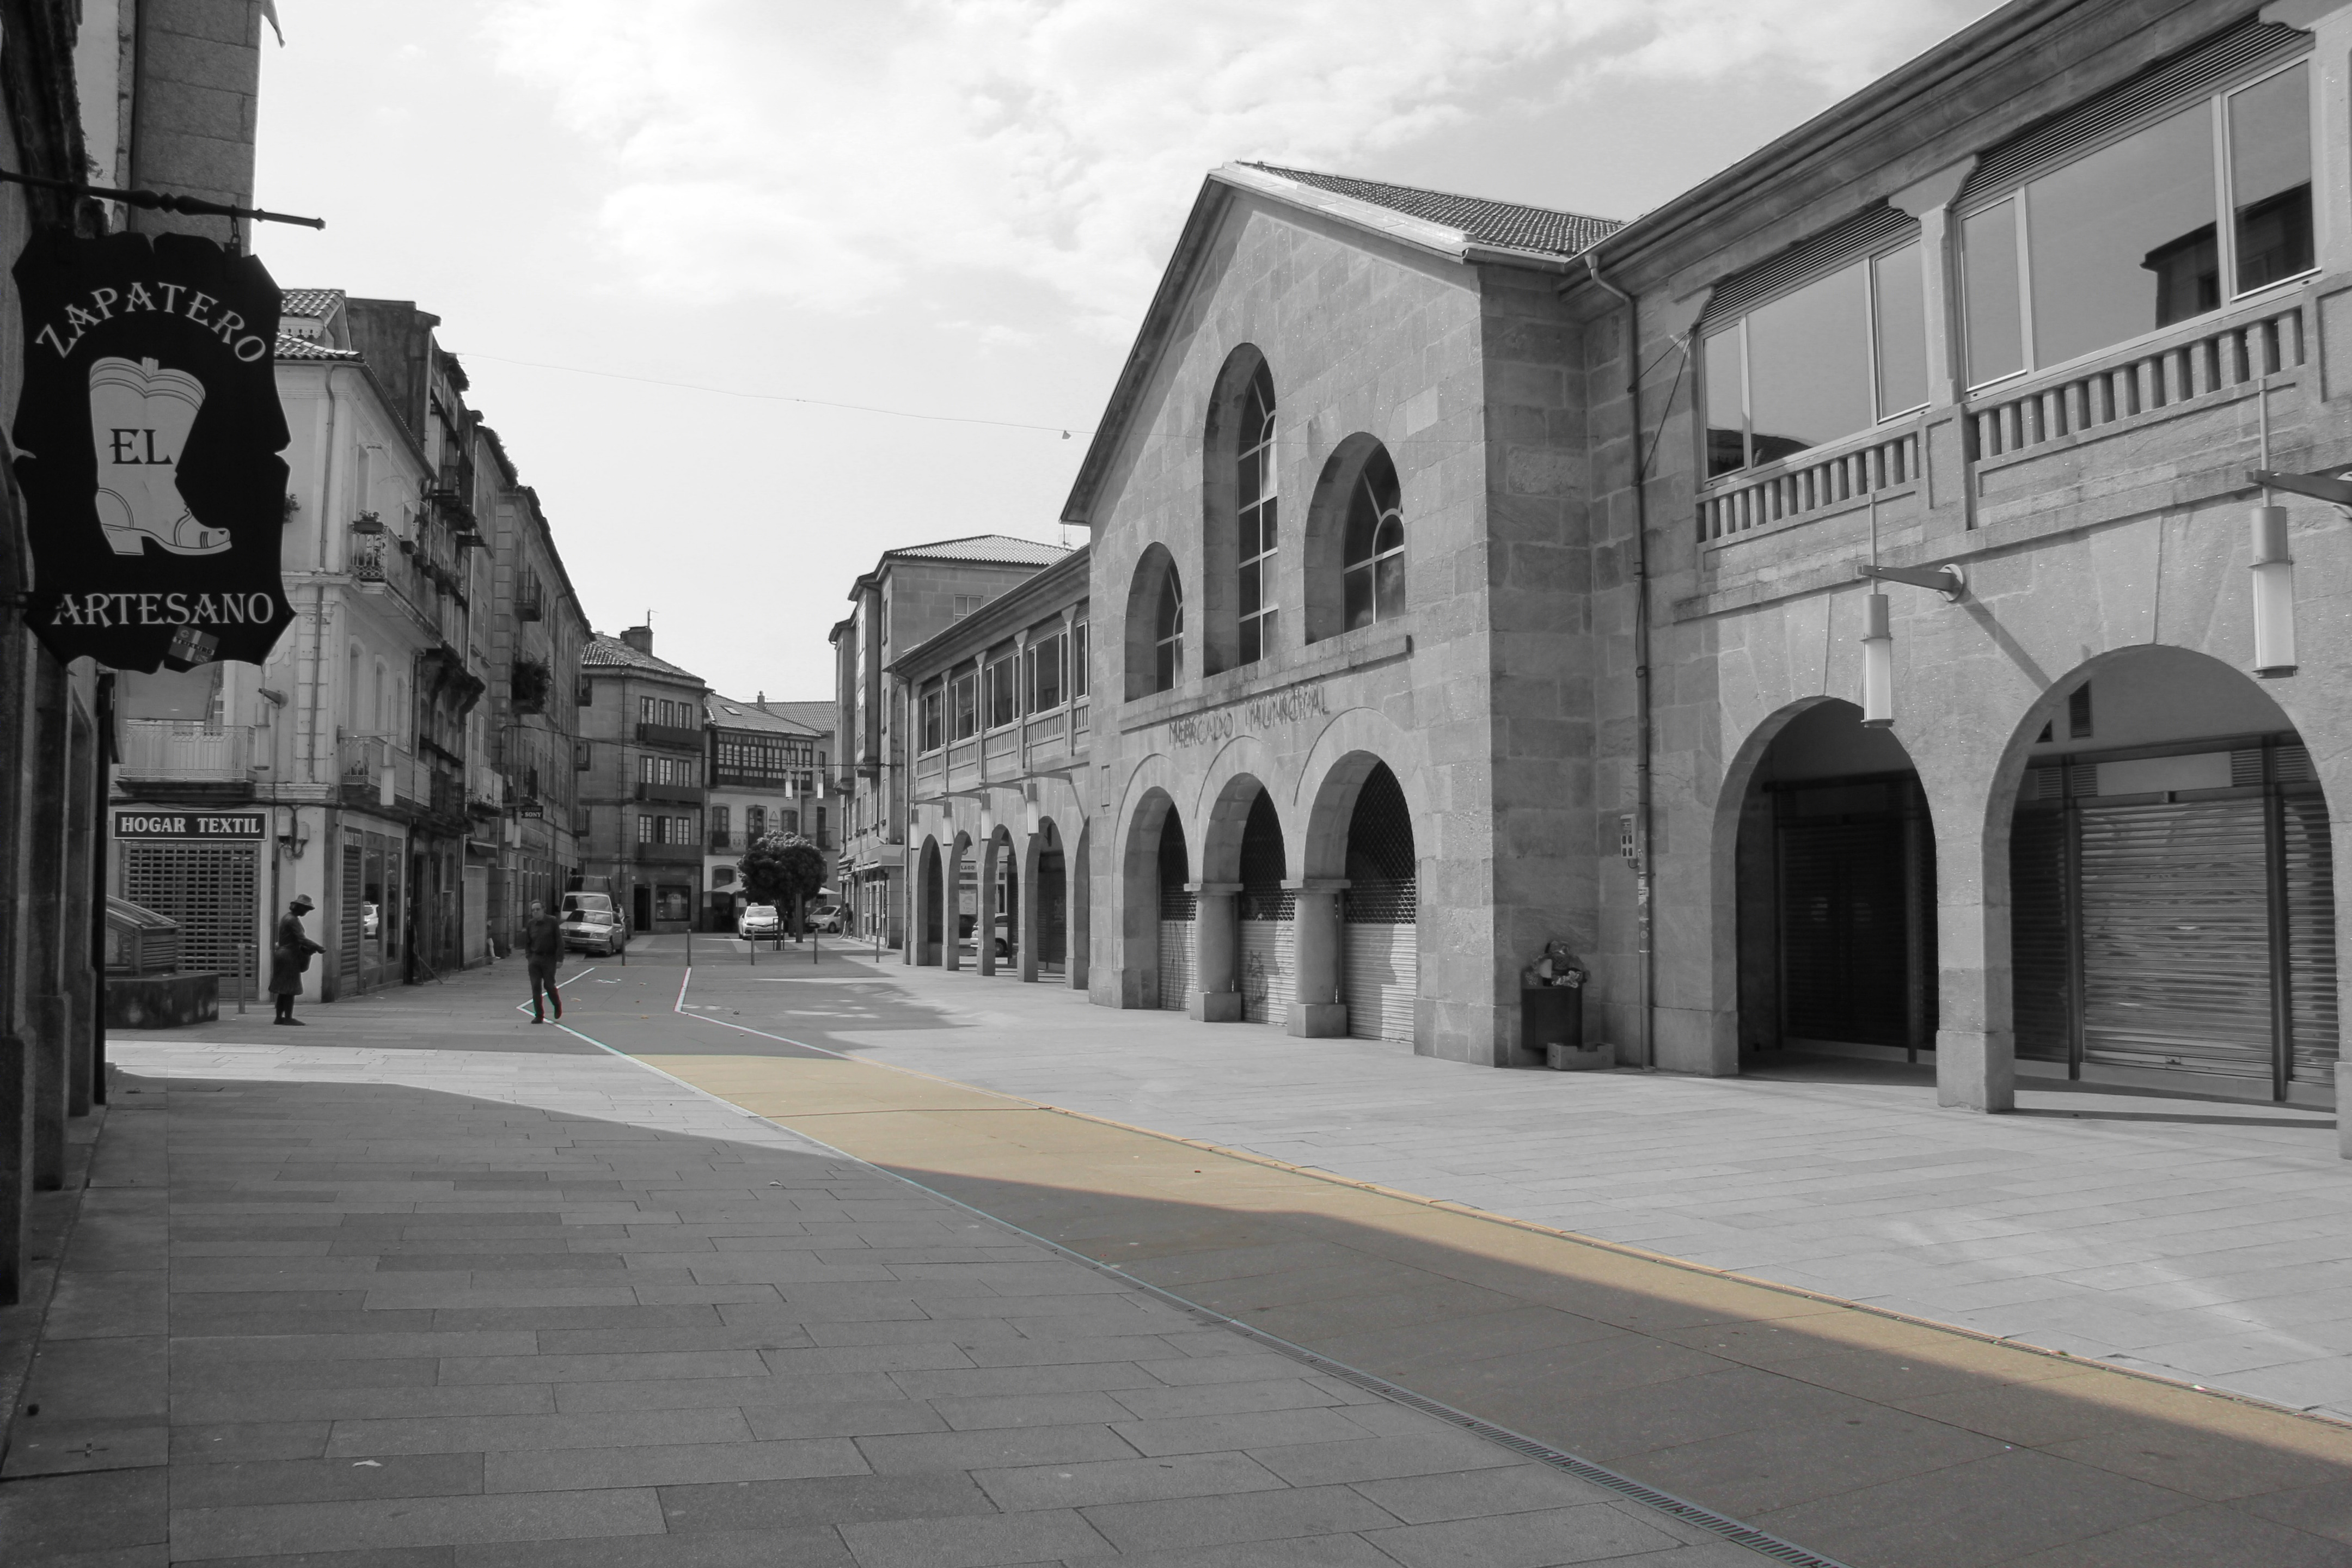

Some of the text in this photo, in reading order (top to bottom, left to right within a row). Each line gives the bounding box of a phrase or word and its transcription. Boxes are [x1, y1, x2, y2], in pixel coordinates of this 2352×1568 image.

[35, 281, 266, 362] ZAPATERO
[109, 428, 174, 465] EL
[51, 592, 274, 627] ARTESANO
[1169, 682, 1330, 750] MERCADO MUNICIPAL
[121, 817, 260, 833] HOGAR TEXTIL
